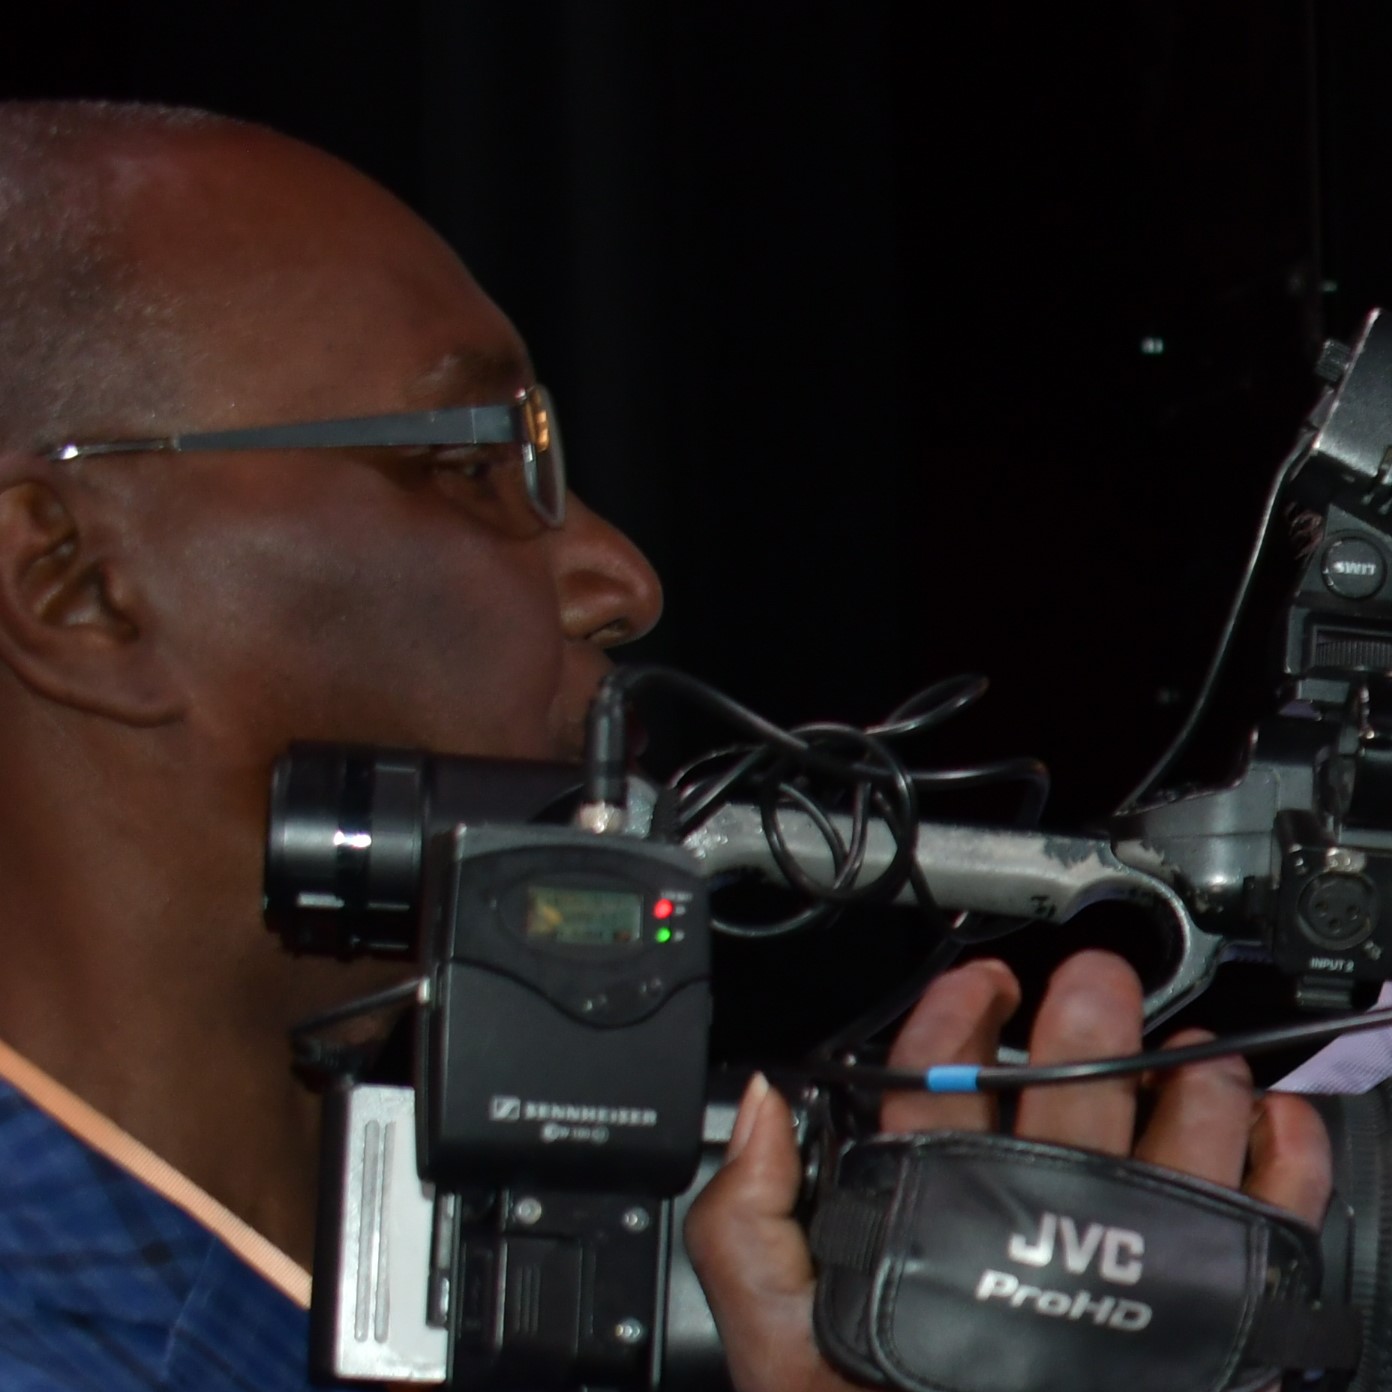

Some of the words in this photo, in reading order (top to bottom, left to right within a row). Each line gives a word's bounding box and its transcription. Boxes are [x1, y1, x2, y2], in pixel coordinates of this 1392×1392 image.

[1309, 956, 1345, 971] INPUT
[1008, 1211, 1146, 1287] JVC
[975, 1268, 1153, 1332] ProHD
